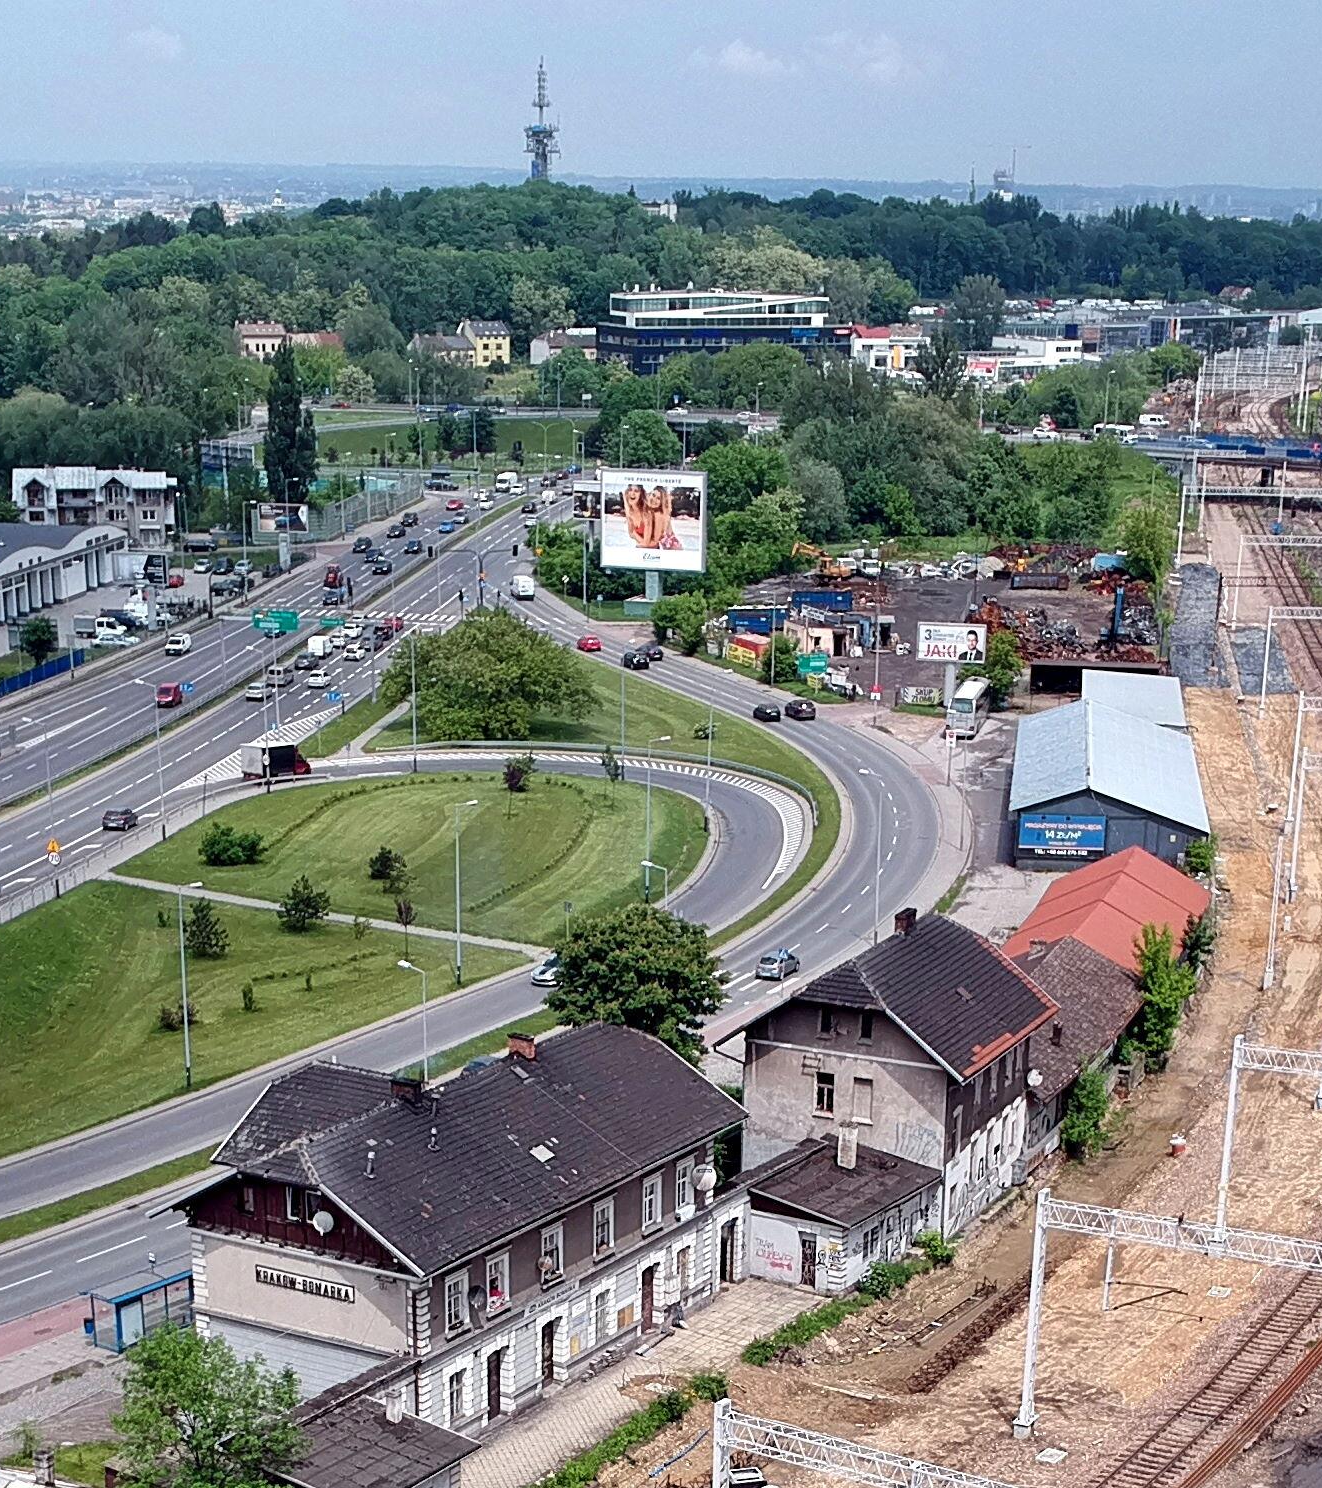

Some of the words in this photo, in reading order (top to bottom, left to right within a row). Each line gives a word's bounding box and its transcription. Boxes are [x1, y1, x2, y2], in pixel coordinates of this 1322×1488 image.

[924, 629, 932, 641] 3
[924, 644, 957, 658] JAKI
[915, 688, 934, 696] SKUP
[1045, 830, 1054, 839] 14
